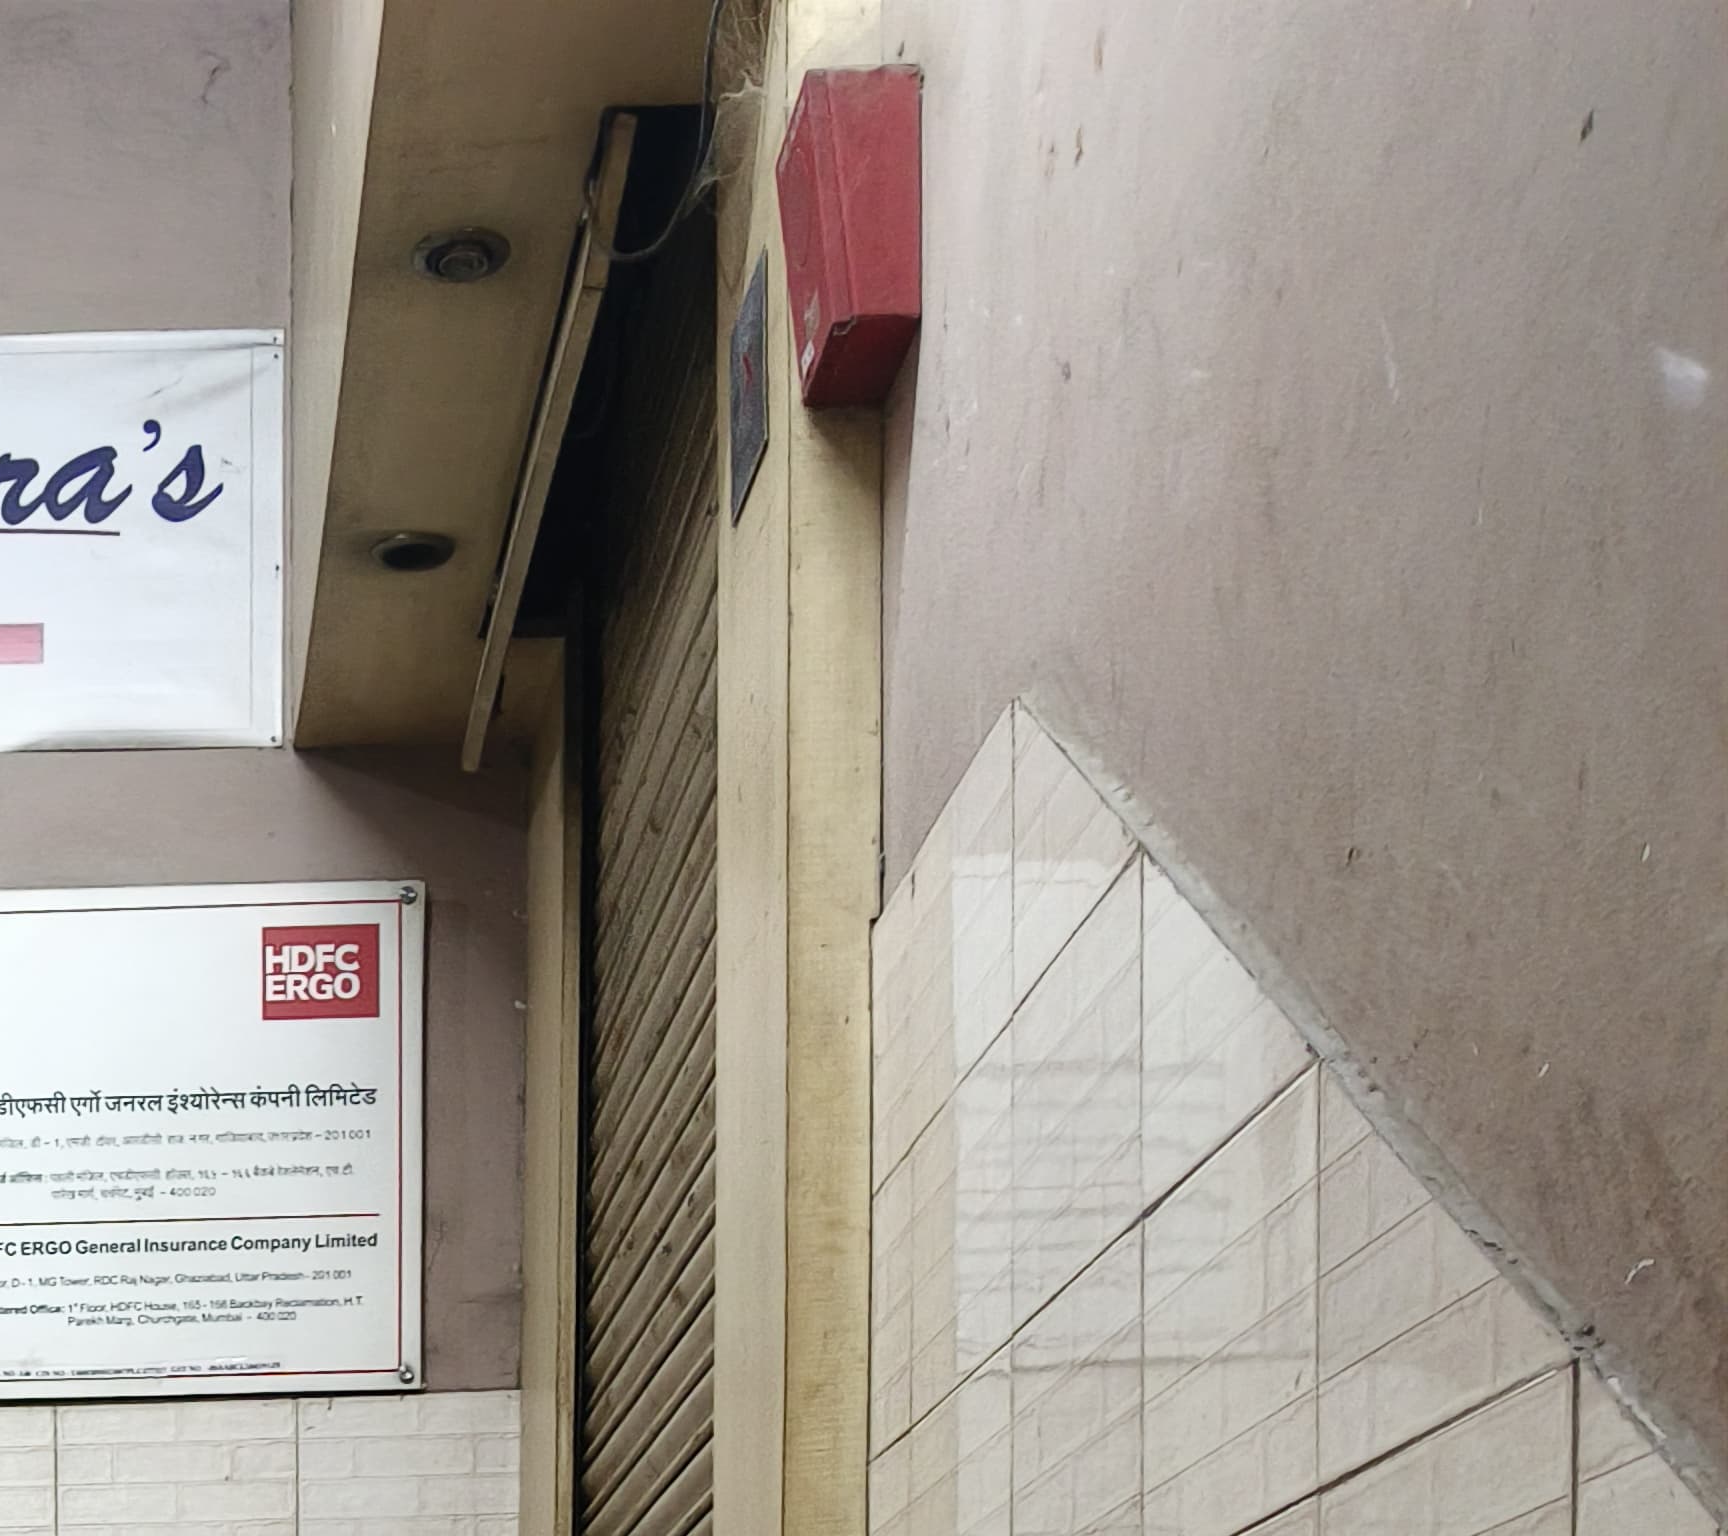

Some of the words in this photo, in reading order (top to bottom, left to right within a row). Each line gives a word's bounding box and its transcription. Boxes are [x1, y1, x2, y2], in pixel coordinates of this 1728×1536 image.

[265, 944, 360, 982] HDFC
[265, 973, 360, 1002] ERGO
[70, 1089, 102, 1116] एर्गो
[105, 1094, 163, 1112] जनरल
[250, 1083, 300, 1108] कंपनी
[304, 1082, 378, 1107] लिमिटेड
[21, 1240, 71, 1256] ERGO
[75, 1238, 141, 1254] General
[144, 1236, 228, 1253] Insurance
[231, 1235, 311, 1253] Company
[315, 1233, 377, 1249] Limited
